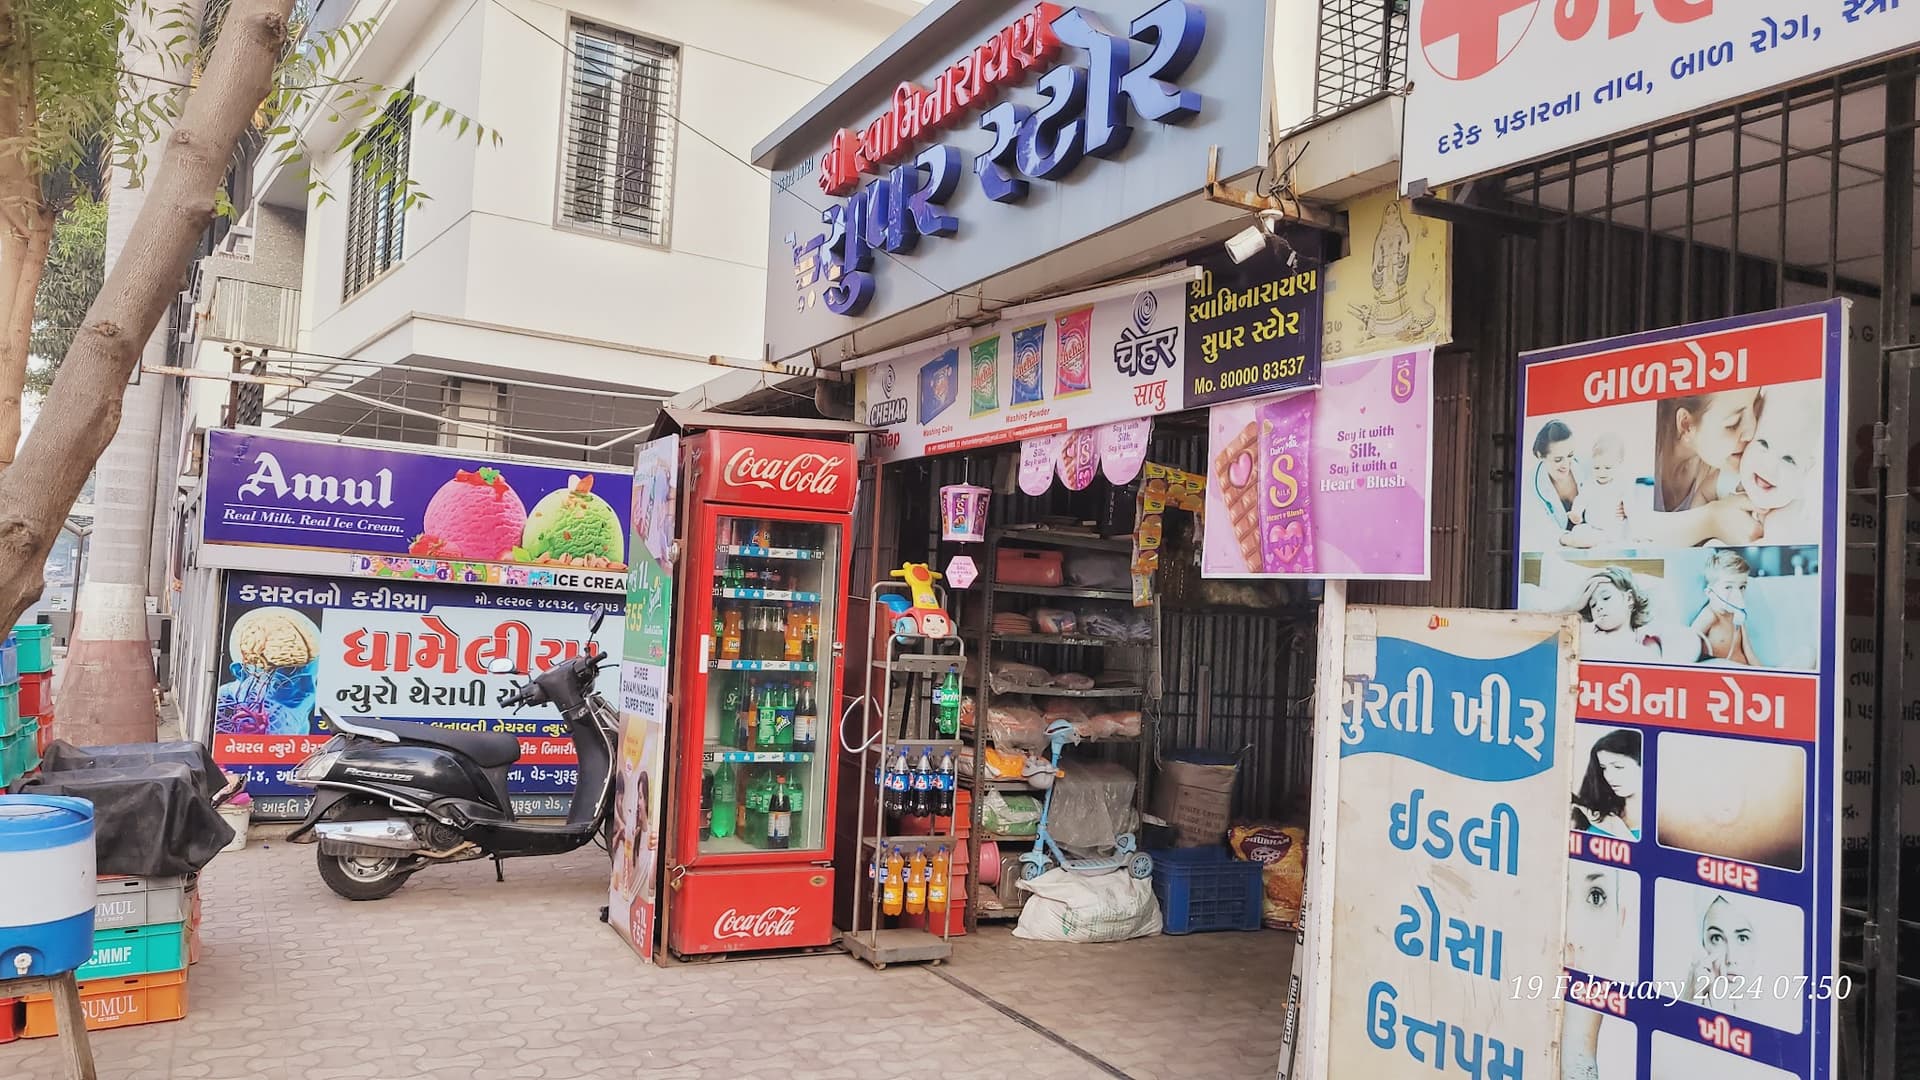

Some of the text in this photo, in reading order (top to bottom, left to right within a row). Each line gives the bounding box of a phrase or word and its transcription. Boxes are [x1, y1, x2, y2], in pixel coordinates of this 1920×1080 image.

[1438, 122, 1482, 155] દરેક
[1493, 91, 1580, 139] પ્રકારના
[1593, 70, 1654, 104] તાવ,
[1670, 40, 1735, 80] બાળ
[1750, 14, 1822, 53] રોગ,
[822, 0, 1206, 317] સુપર સ્ટોર
[1188, 270, 1317, 323] સ્વામિનારાયણ
[1190, 270, 1213, 299] શ્રી
[1201, 307, 1299, 364] સુપર સ્ટોર
[1114, 327, 1178, 377] चेहर
[1194, 355, 1305, 395] Mo. 80000 83537
[1583, 341, 1748, 404] બાળરોગ
[1133, 379, 1168, 412] साबु
[870, 397, 908, 427] CHEHAR
[1006, 408, 1050, 424] Washing Powder
[1337, 425, 1394, 443] Say it with
[1349, 442, 1381, 459] Silk,
[238, 451, 394, 509] Amul
[724, 447, 845, 495] Coca-Cola
[1329, 459, 1397, 476] Say it with a
[1320, 474, 1406, 492] Heart Blush
[223, 508, 404, 533] Real Milk. Real Ice Cream.
[239, 583, 341, 606] કસરતનો
[553, 574, 578, 587] ICE
[583, 577, 627, 591] CREA
[474, 592, 491, 605] મો.
[633, 666, 649, 681] SHREE
[336, 675, 398, 713] ન્યુરો
[409, 677, 486, 707] થેરાપી
[625, 697, 655, 716] SUPER STORE
[1579, 672, 1785, 729] મડીના રોગ
[493, 719, 537, 734] નેચરલ
[1341, 667, 1546, 762] સુરતી ખીરૂ
[225, 738, 326, 758] નેચરલ ન્યુરો થેર
[541, 741, 578, 755] બિમારી
[531, 766, 578, 785] વેડ-ગુરૂકુ
[1389, 788, 1519, 876] ઈડલી
[1588, 836, 1632, 865] વાળ
[97, 901, 136, 917] MUL
[714, 906, 800, 940] Coca-Cola
[1394, 886, 1502, 981] ઢોસા
[82, 947, 132, 966] CMMF
[80, 995, 138, 1019] SUMUL
[1284, 976, 1299, 1043] EUROSTAR
[1697, 1014, 1752, 1056] ખીલ
